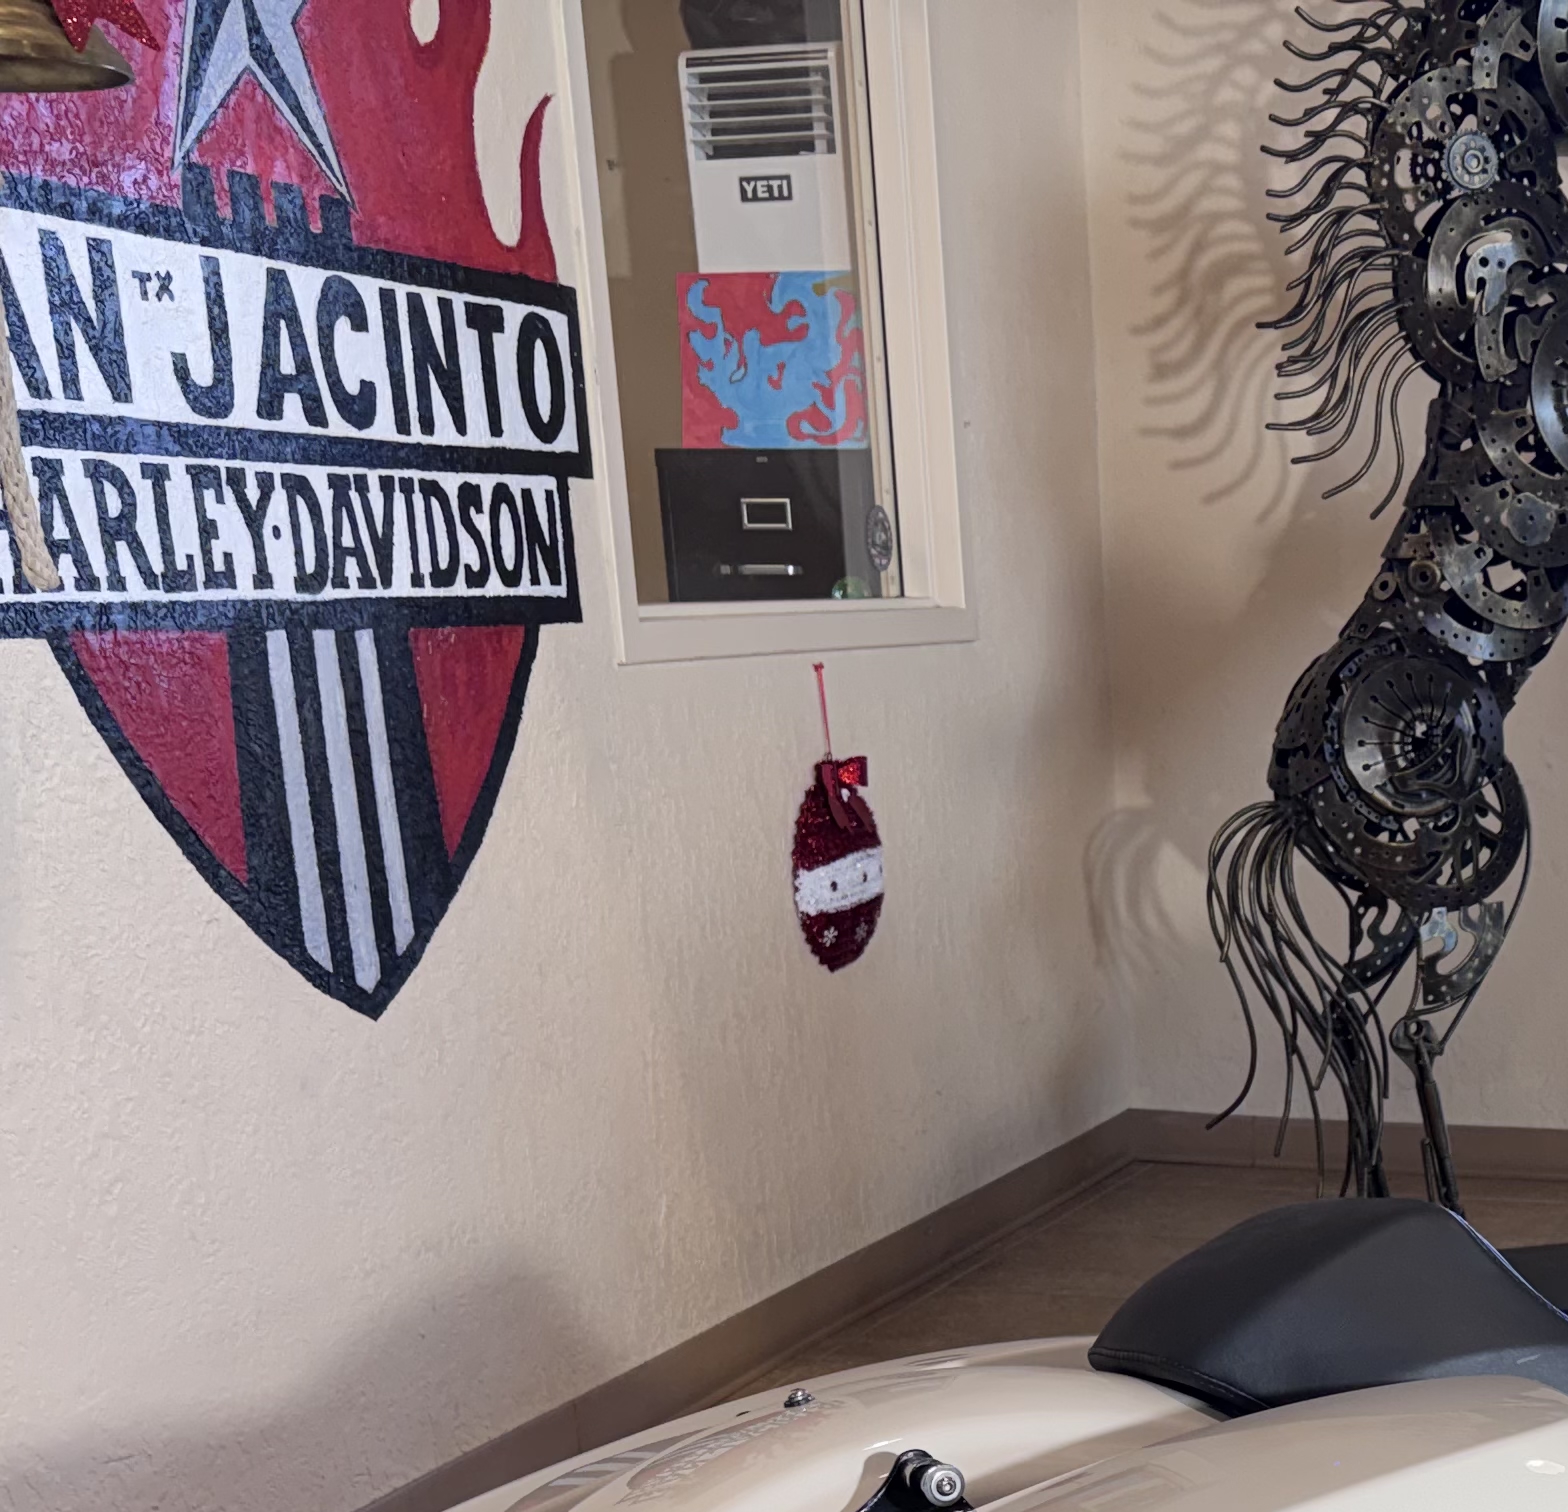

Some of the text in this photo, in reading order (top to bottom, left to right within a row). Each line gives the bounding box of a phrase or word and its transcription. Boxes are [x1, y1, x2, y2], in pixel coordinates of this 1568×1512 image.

[742, 180, 789, 199] YETI
[132, 270, 175, 302] TX
[171, 255, 565, 445] JACINTO
